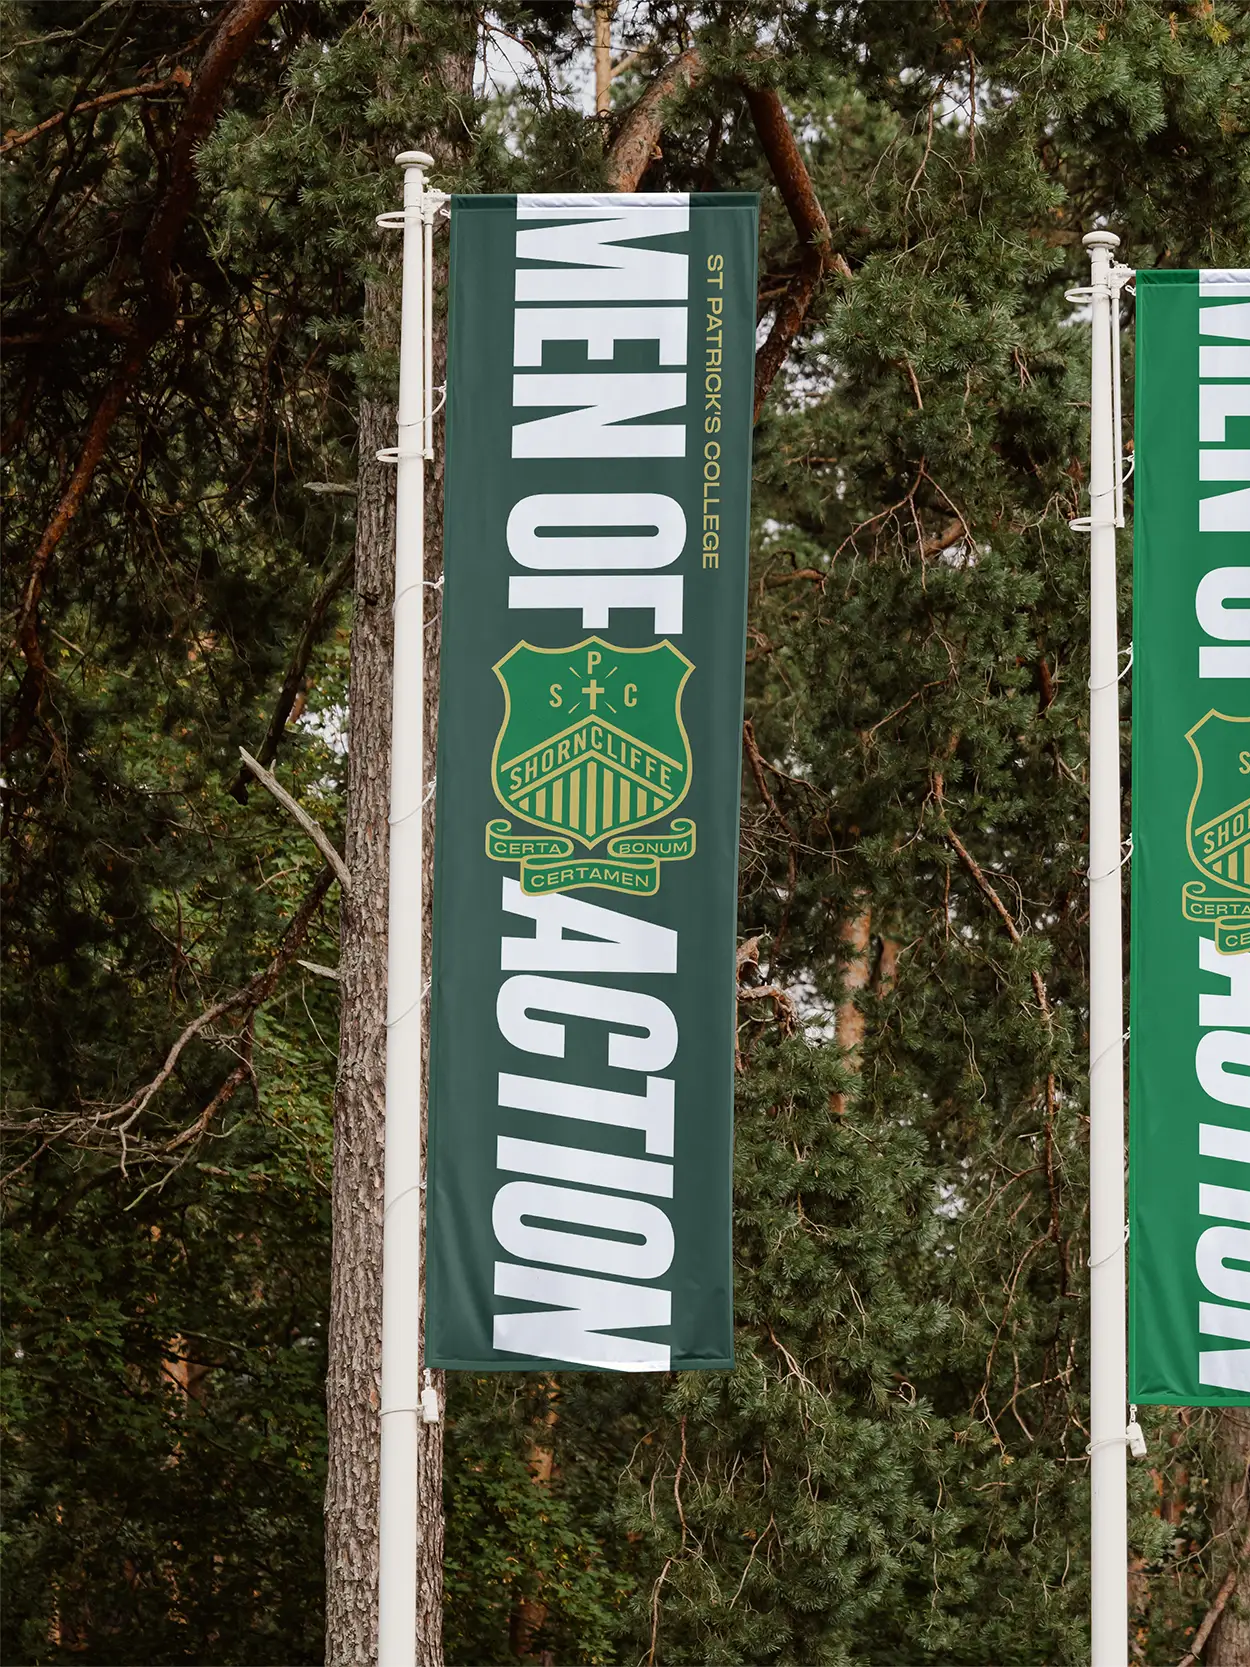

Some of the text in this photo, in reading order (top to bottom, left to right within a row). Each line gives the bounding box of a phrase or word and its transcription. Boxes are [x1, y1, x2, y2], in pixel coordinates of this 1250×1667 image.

[702, 254, 723, 569] ST PATRICK'S COLLEGE
[587, 651, 602, 675] P
[549, 683, 638, 708] S C
[509, 725, 672, 790] SHORNCLIFFE
[1238, 751, 1250, 775] S
[492, 193, 690, 1372] MEN OF ACTION
[493, 841, 688, 855] CERTA BONUM
[530, 867, 649, 888] CERTAMEN
